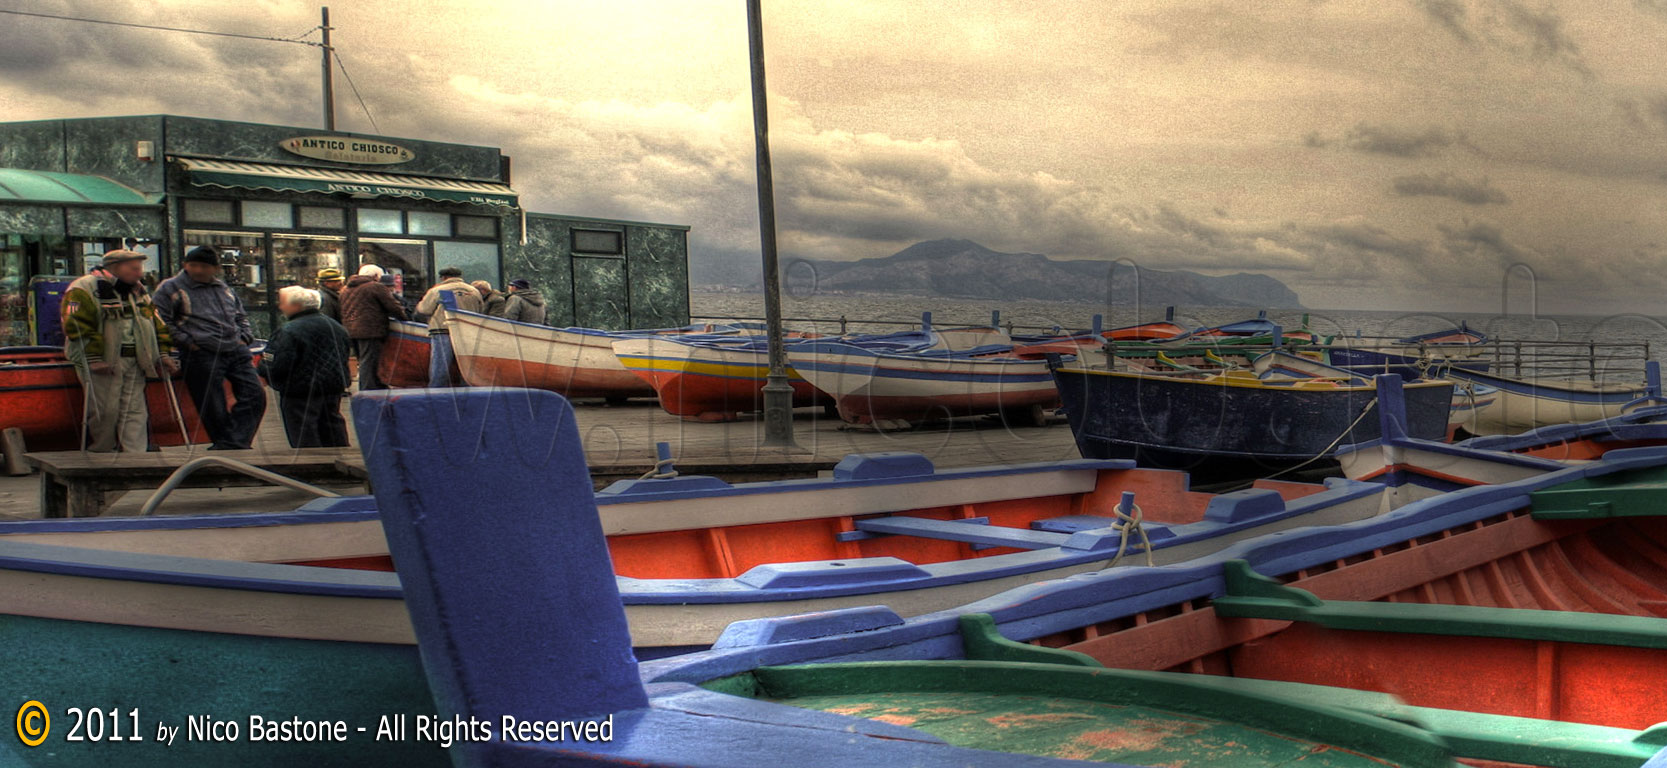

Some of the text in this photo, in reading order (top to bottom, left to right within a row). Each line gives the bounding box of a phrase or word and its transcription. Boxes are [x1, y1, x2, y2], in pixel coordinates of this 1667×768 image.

[303, 139, 398, 155] ANTICO CHIOSCO
[328, 183, 425, 197] ANTICO CHIOSCO
